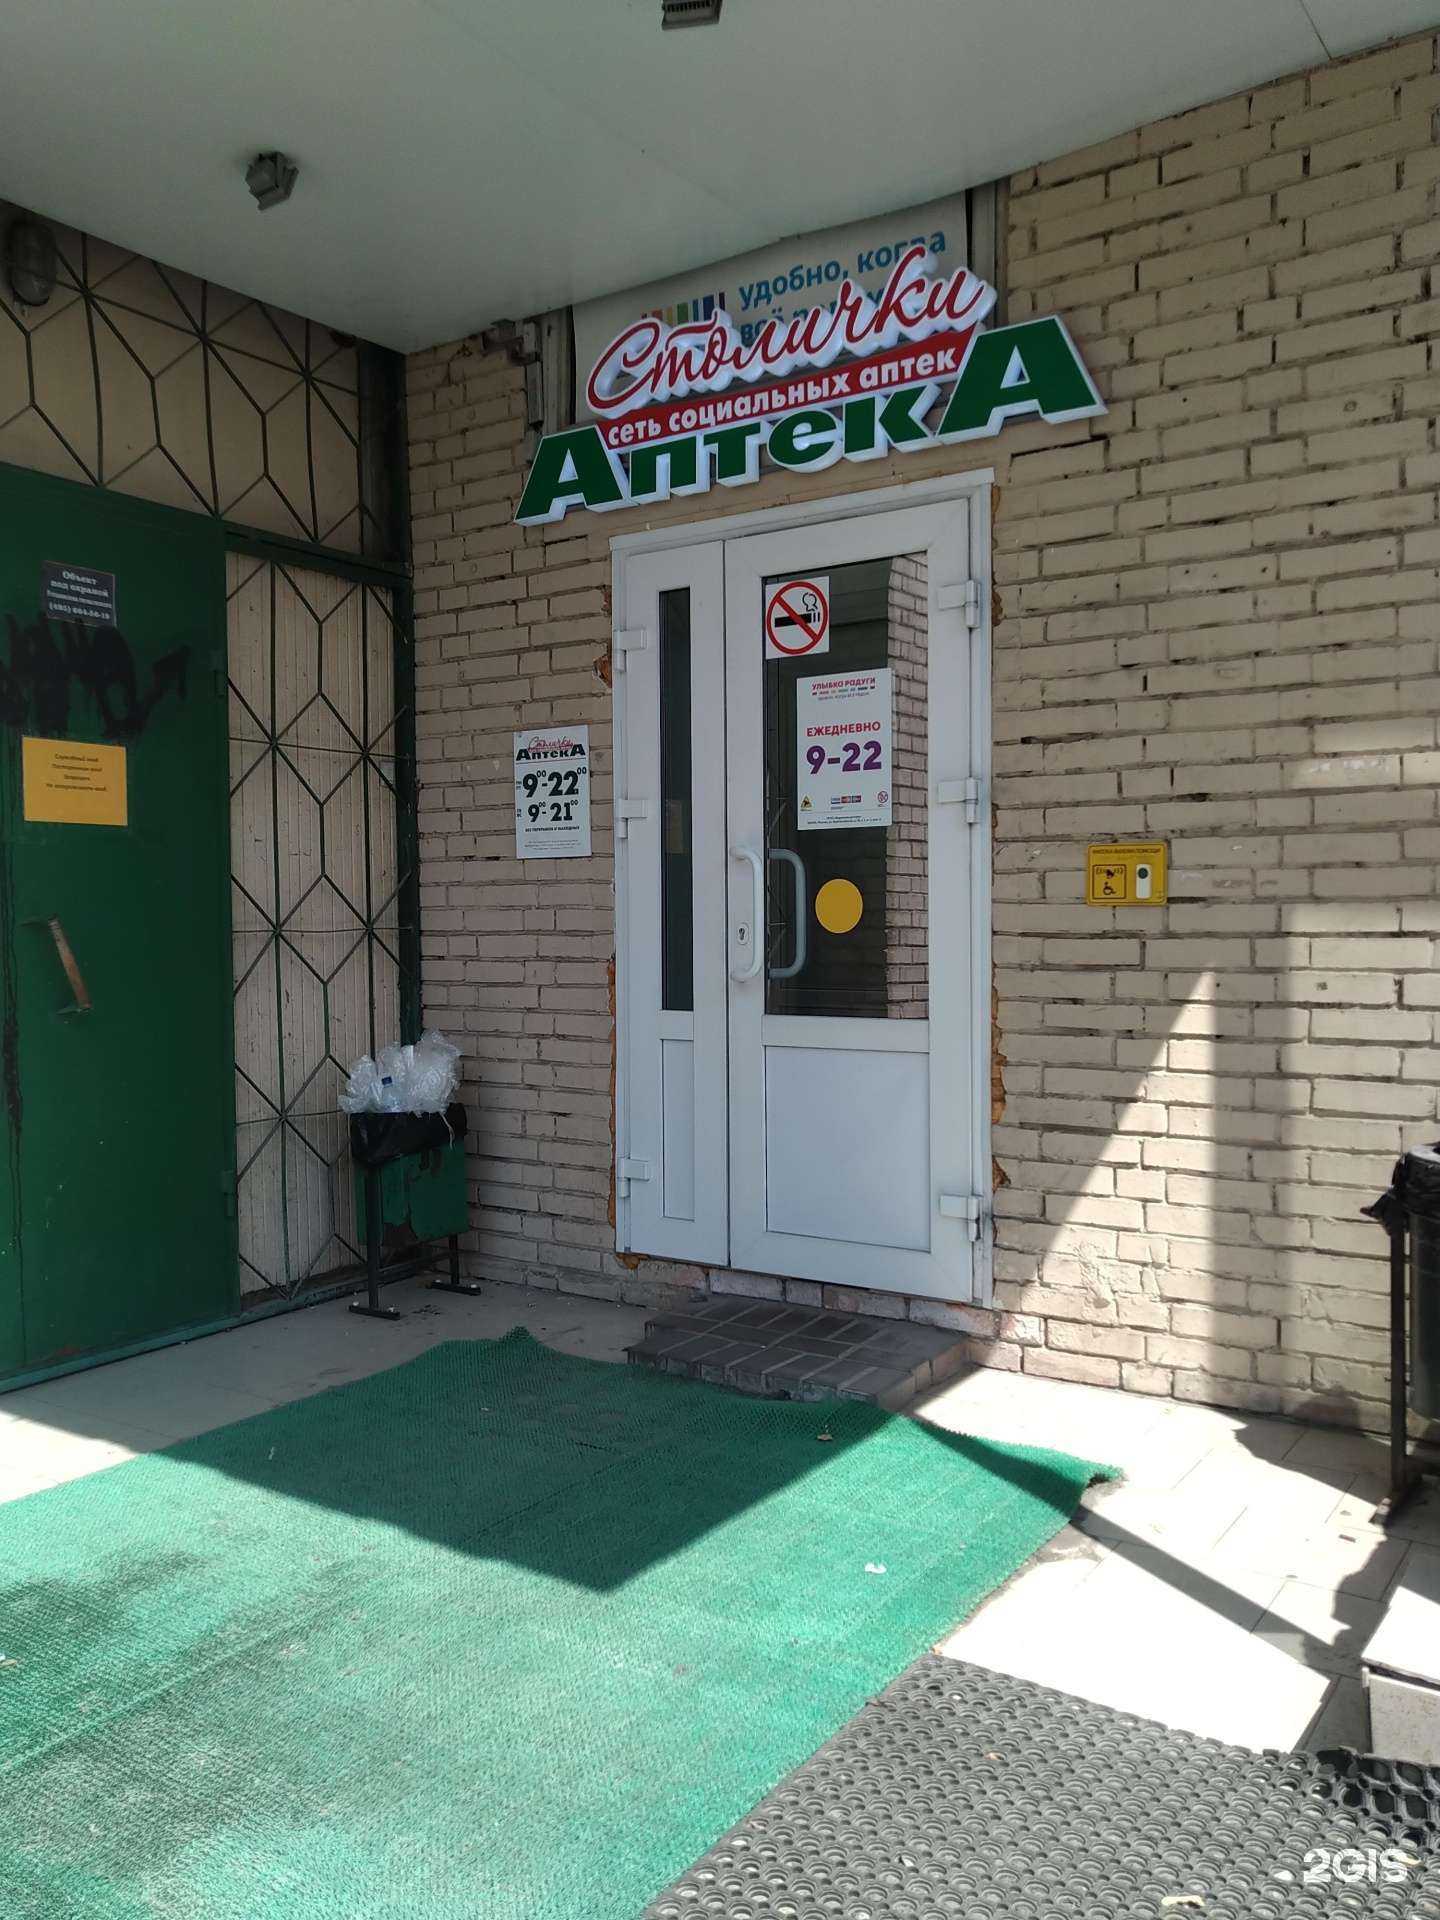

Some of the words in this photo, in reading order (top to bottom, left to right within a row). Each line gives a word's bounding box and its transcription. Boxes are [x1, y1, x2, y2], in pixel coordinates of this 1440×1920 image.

[587, 246, 985, 410] Столички
[608, 418, 661, 447] сеть
[668, 371, 850, 429] социальных
[859, 346, 957, 389] аптек
[806, 721, 881, 737] ЕЖЕДНЕВНО
[806, 740, 882, 775] 9-22
